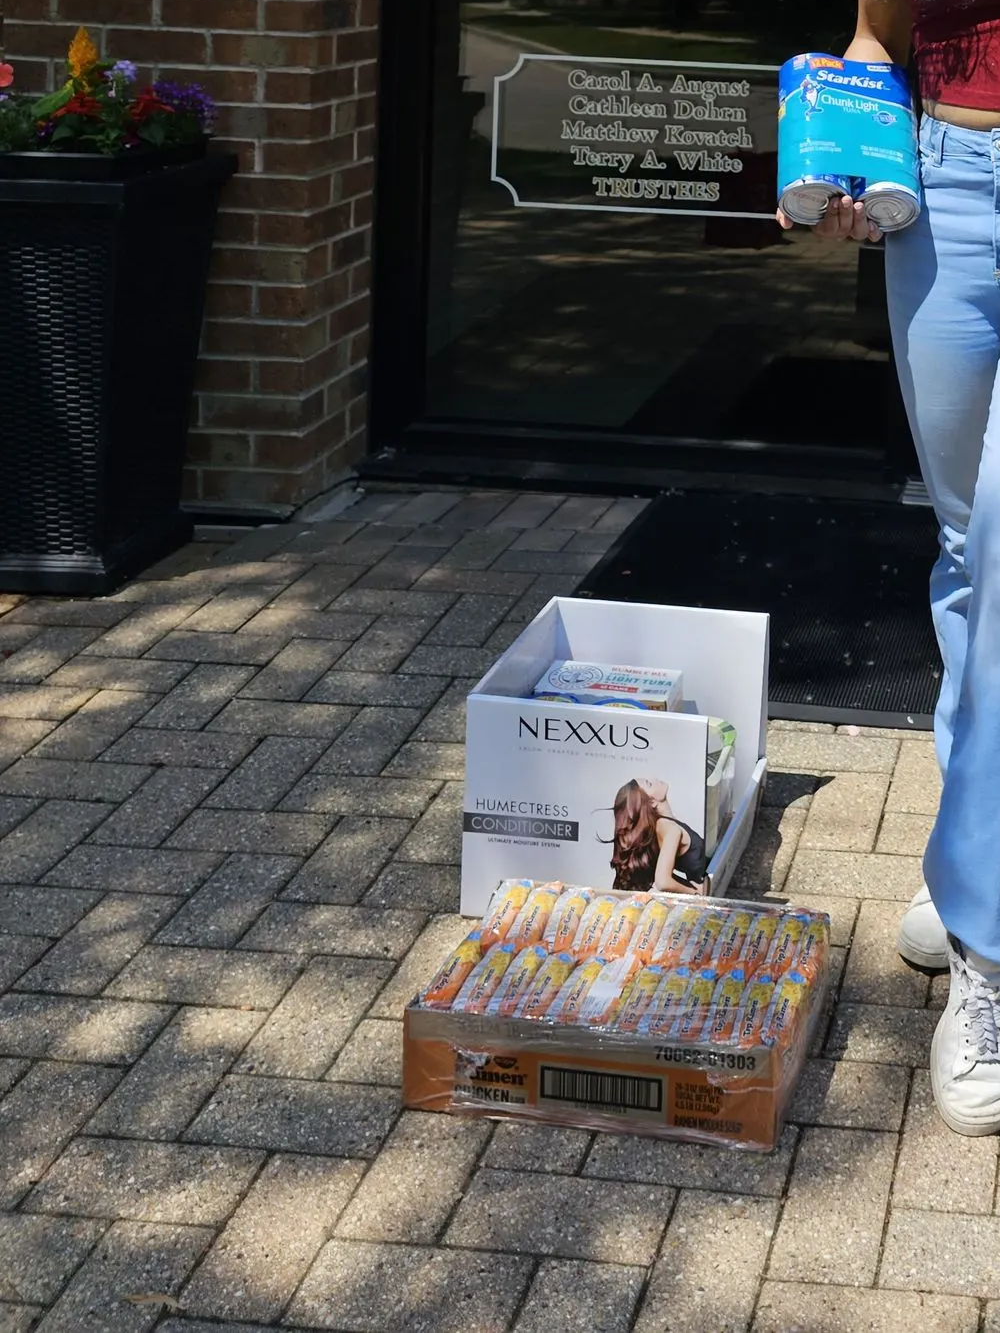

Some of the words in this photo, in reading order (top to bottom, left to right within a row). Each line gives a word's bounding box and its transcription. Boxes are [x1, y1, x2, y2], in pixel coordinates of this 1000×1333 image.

[568, 69, 631, 91] Carol
[636, 73, 662, 93] A.
[670, 74, 750, 100] August
[816, 70, 884, 90] StarKist
[568, 95, 667, 119] Cathleen
[674, 100, 747, 122] Dohrn
[821, 95, 854, 107] Chunk
[855, 99, 879, 113] Light
[561, 119, 658, 144] Matthew
[664, 125, 752, 148] Kovatch
[570, 146, 634, 173] Terry
[640, 149, 666, 170] A.
[673, 150, 743, 173] White
[592, 176, 720, 201] TRUSTEES
[605, 673, 639, 683] LIGHT
[643, 679, 673, 687] TUNA
[519, 716, 650, 750] NEXXUS
[476, 797, 569, 818] HUMECTRESS
[471, 816, 573, 837] CONDITIONER
